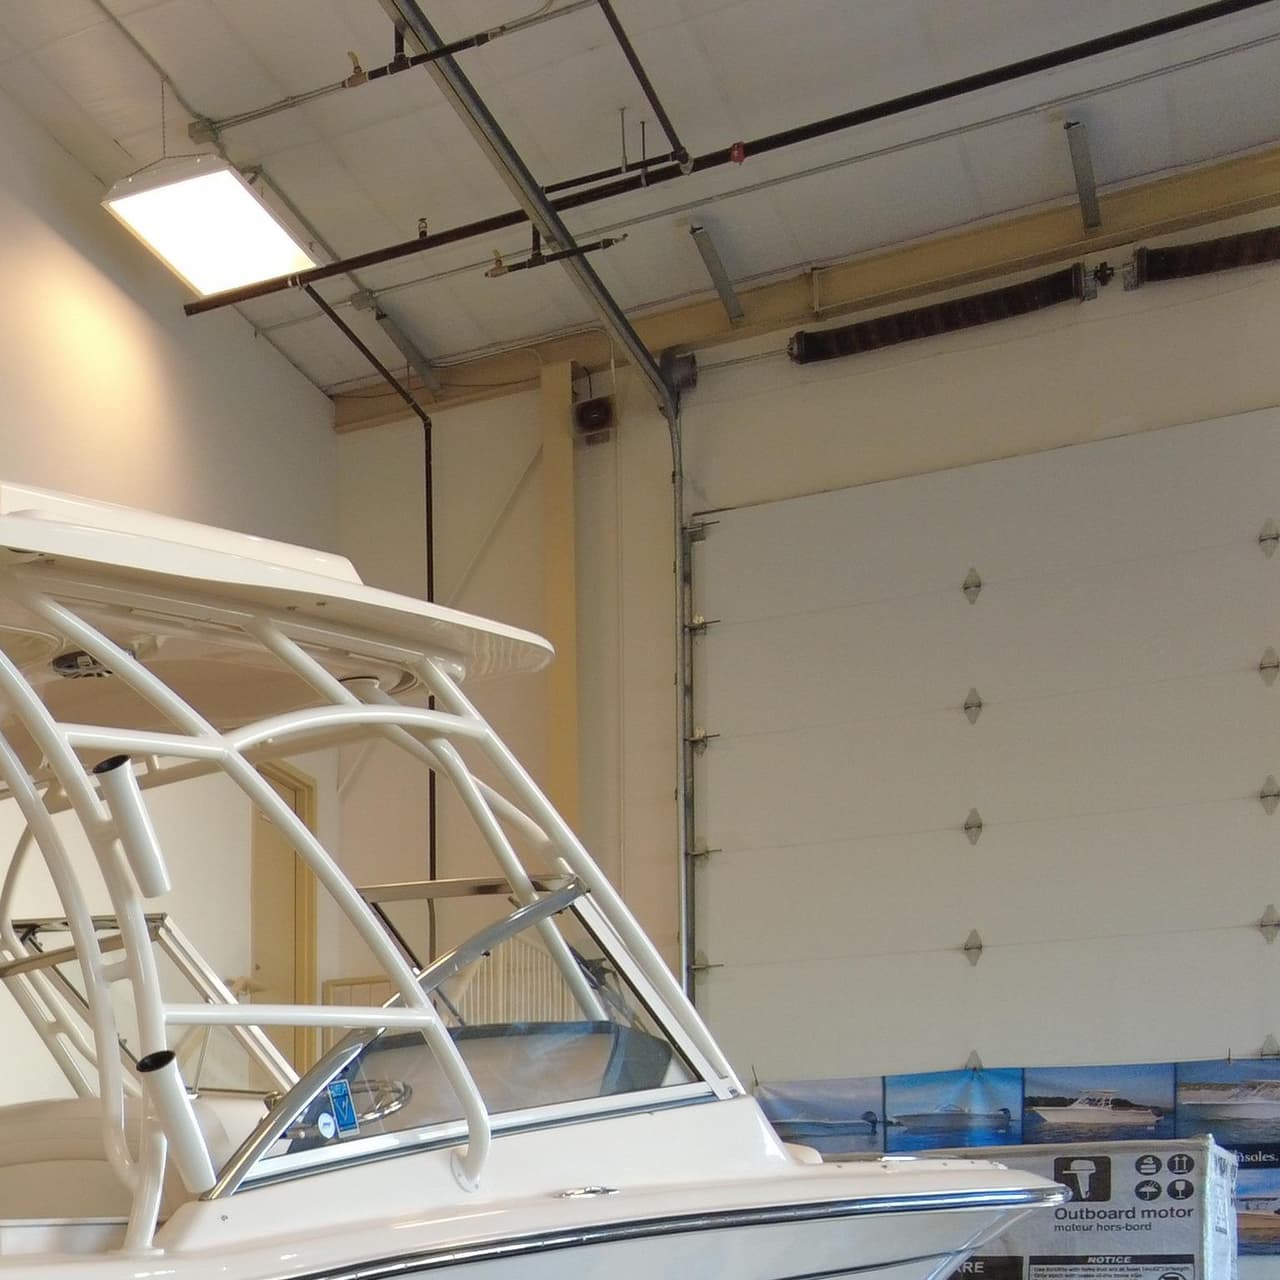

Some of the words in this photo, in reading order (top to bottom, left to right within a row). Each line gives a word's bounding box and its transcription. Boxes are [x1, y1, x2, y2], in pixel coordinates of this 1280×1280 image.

[1054, 1207, 1136, 1221] Outboard
[1141, 1207, 1194, 1219] motor
[1054, 1223, 1093, 1232] moteur
[1096, 1221, 1152, 1232] hors-bord
[1088, 1256, 1132, 1264] NOTICE
